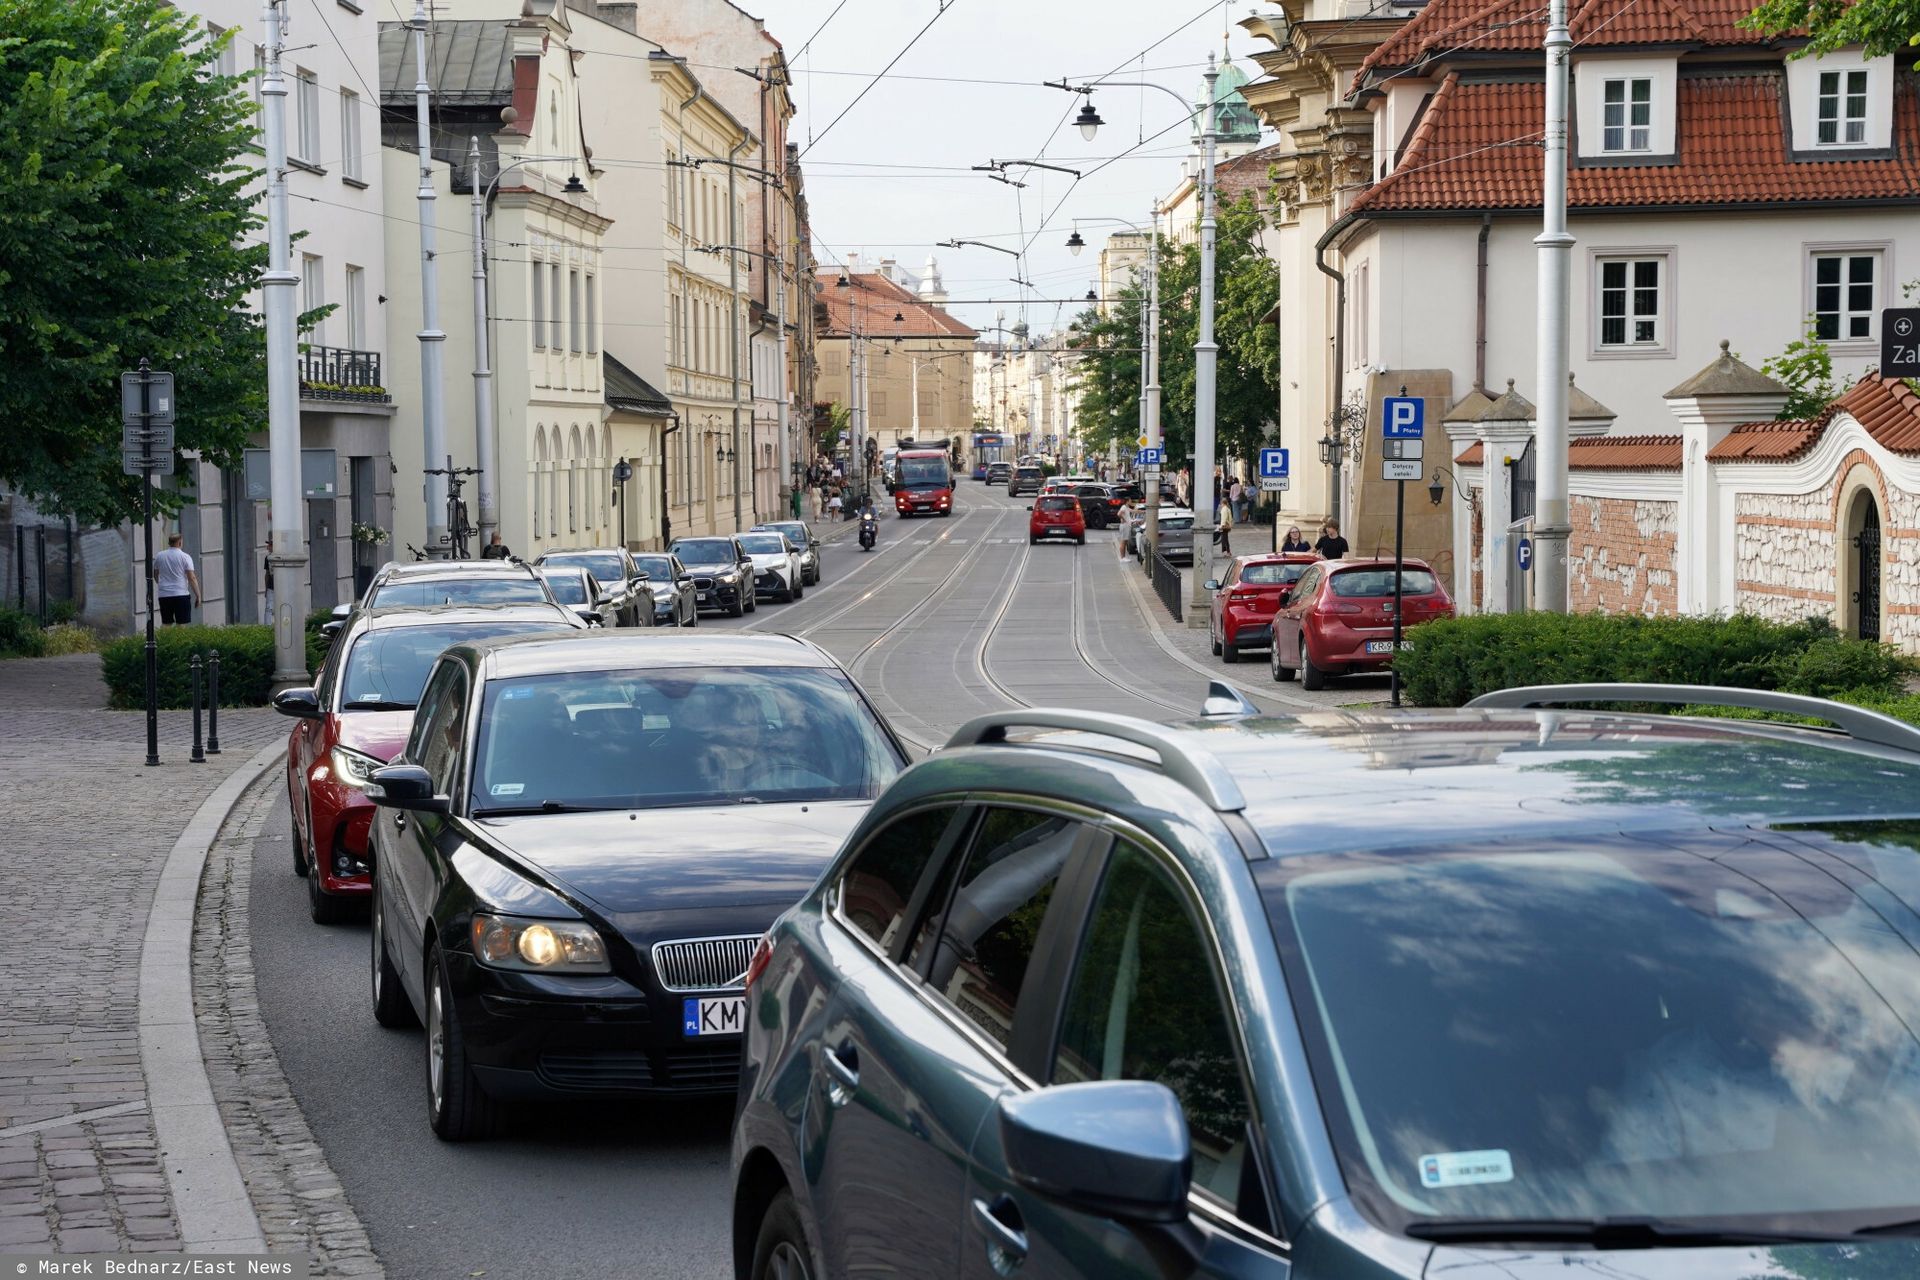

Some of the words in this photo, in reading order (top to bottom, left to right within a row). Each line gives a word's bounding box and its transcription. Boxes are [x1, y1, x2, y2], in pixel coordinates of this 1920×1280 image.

[1392, 402, 1415, 433] P
[1266, 452, 1283, 474] P
[1392, 463, 1414, 471] Dotyczy
[1520, 547, 1531, 563] P
[686, 1021, 698, 1030] PL
